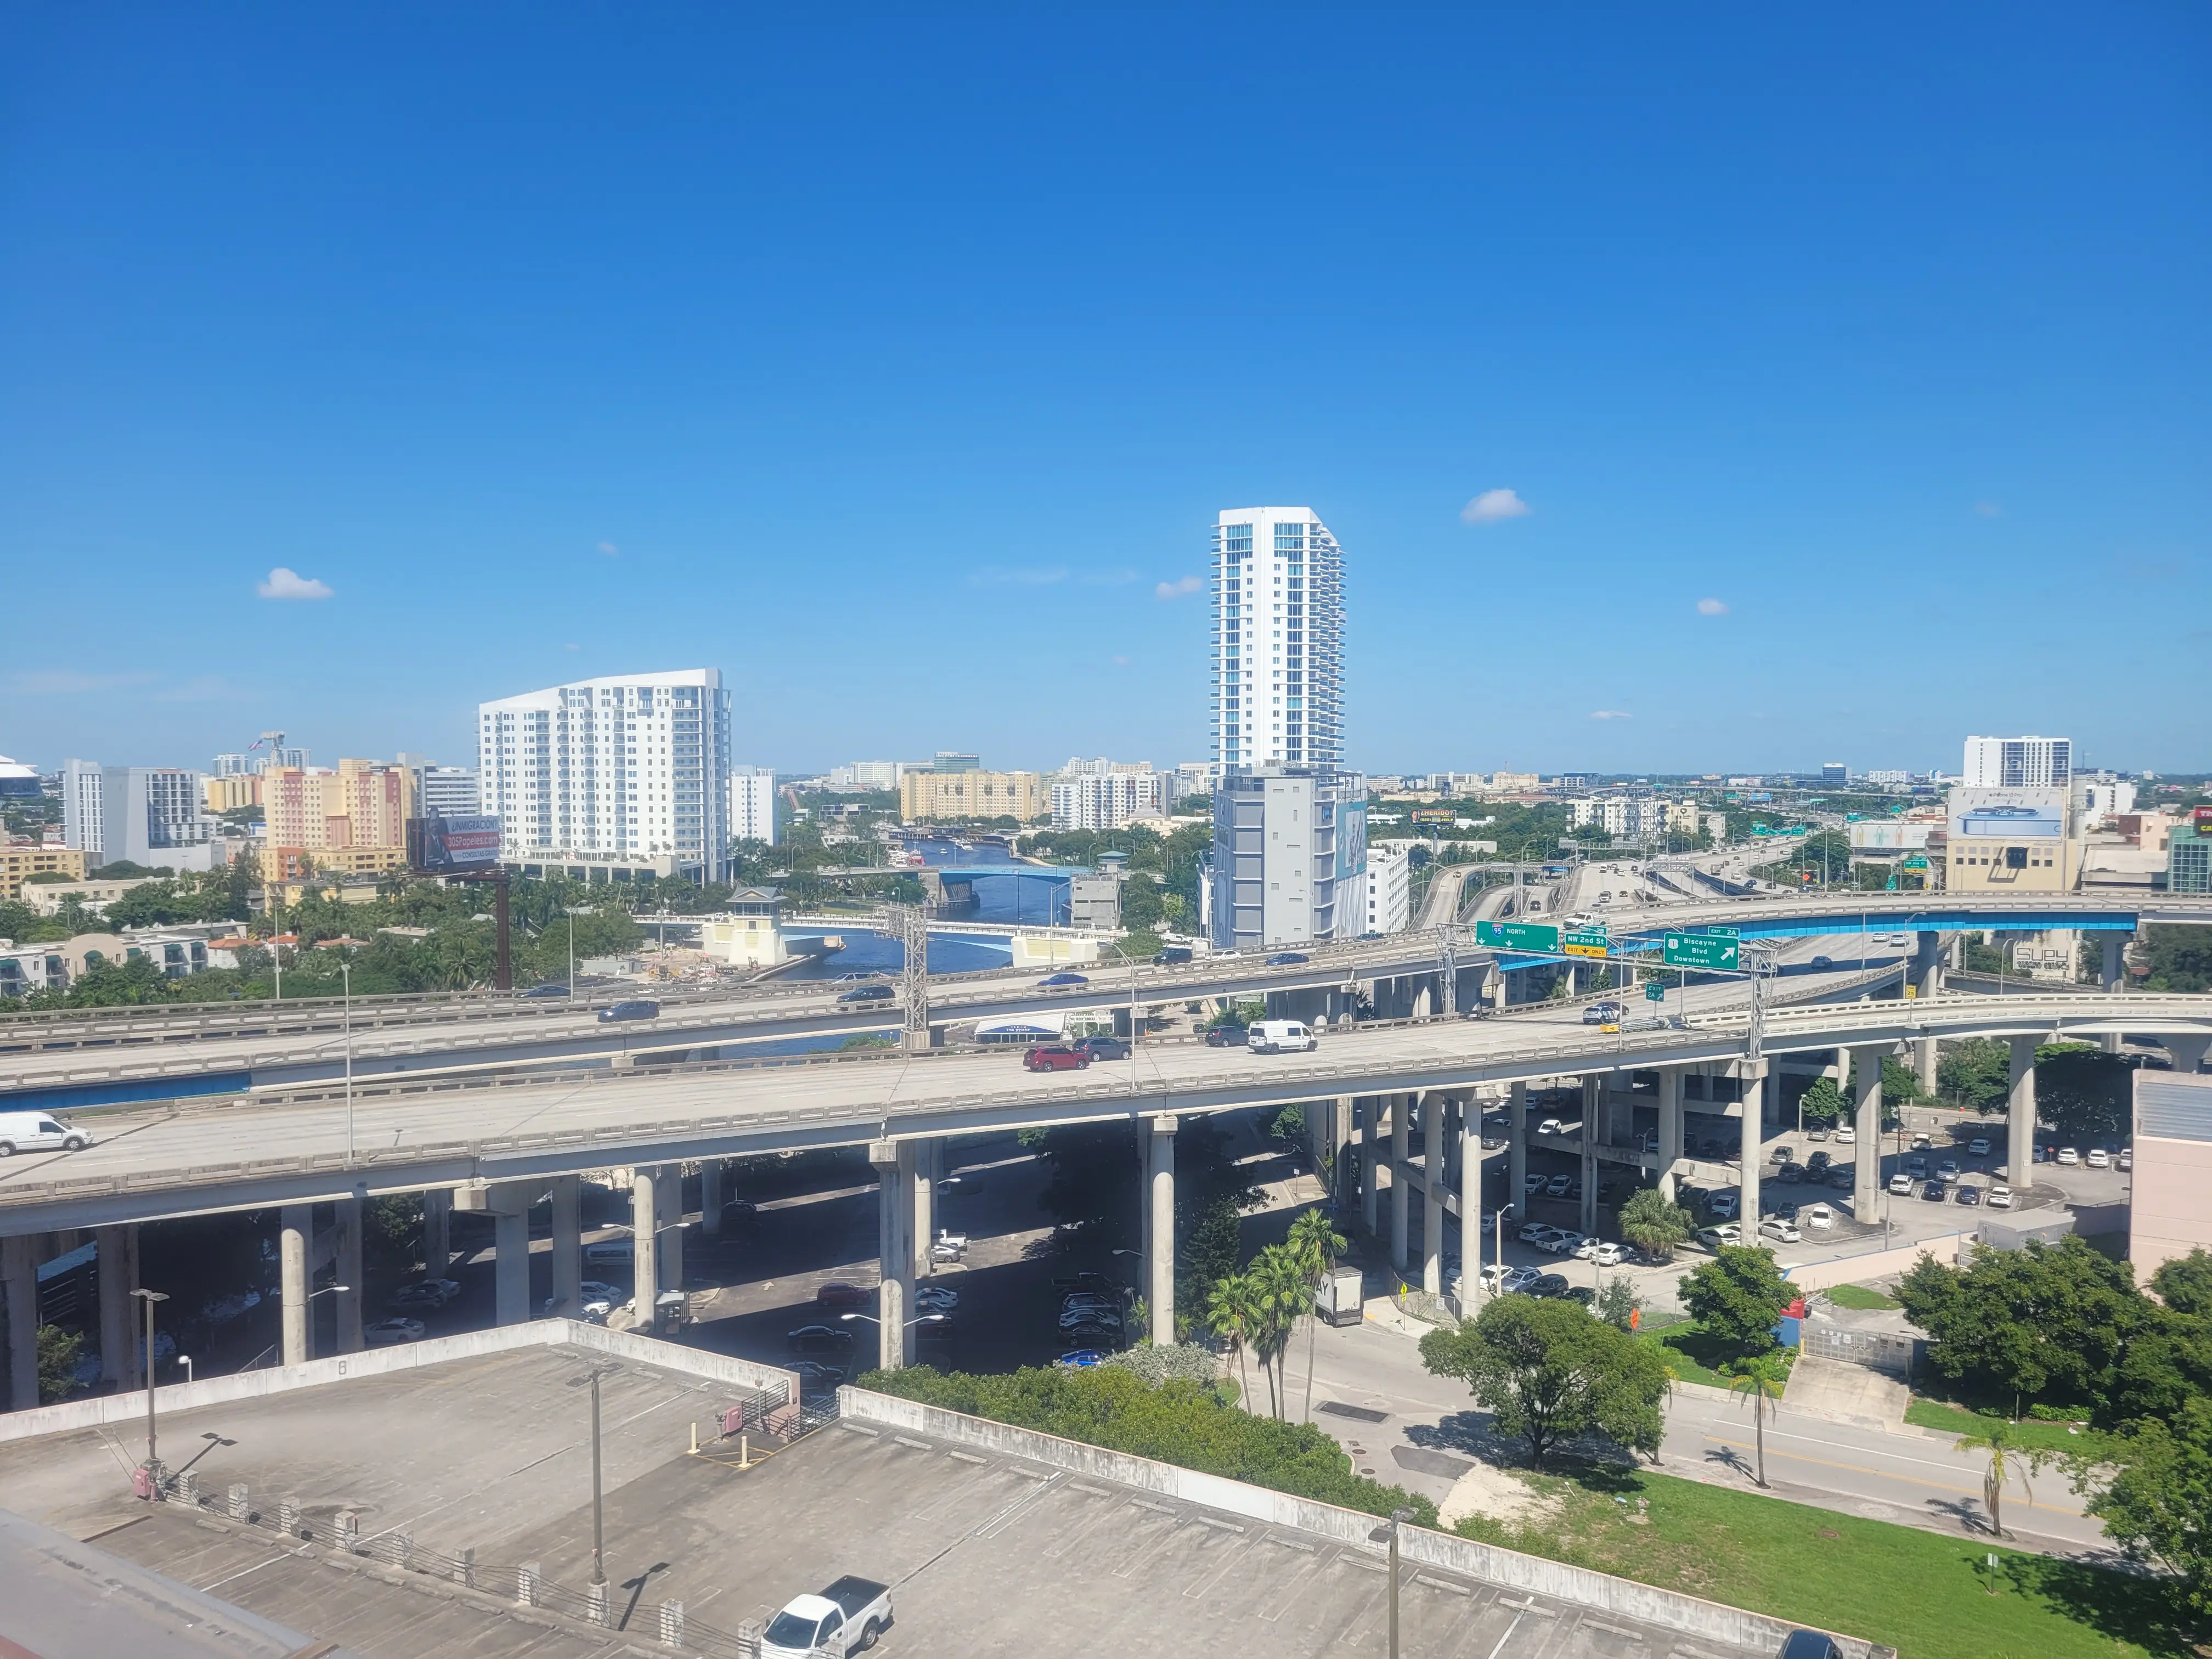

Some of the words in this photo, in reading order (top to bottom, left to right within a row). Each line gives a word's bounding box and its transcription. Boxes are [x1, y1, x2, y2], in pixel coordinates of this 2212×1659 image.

[448, 835, 498, 848] 305Papeles.com
[1684, 938, 1717, 946] Biscayne
[1674, 955, 1710, 964] Downtown
